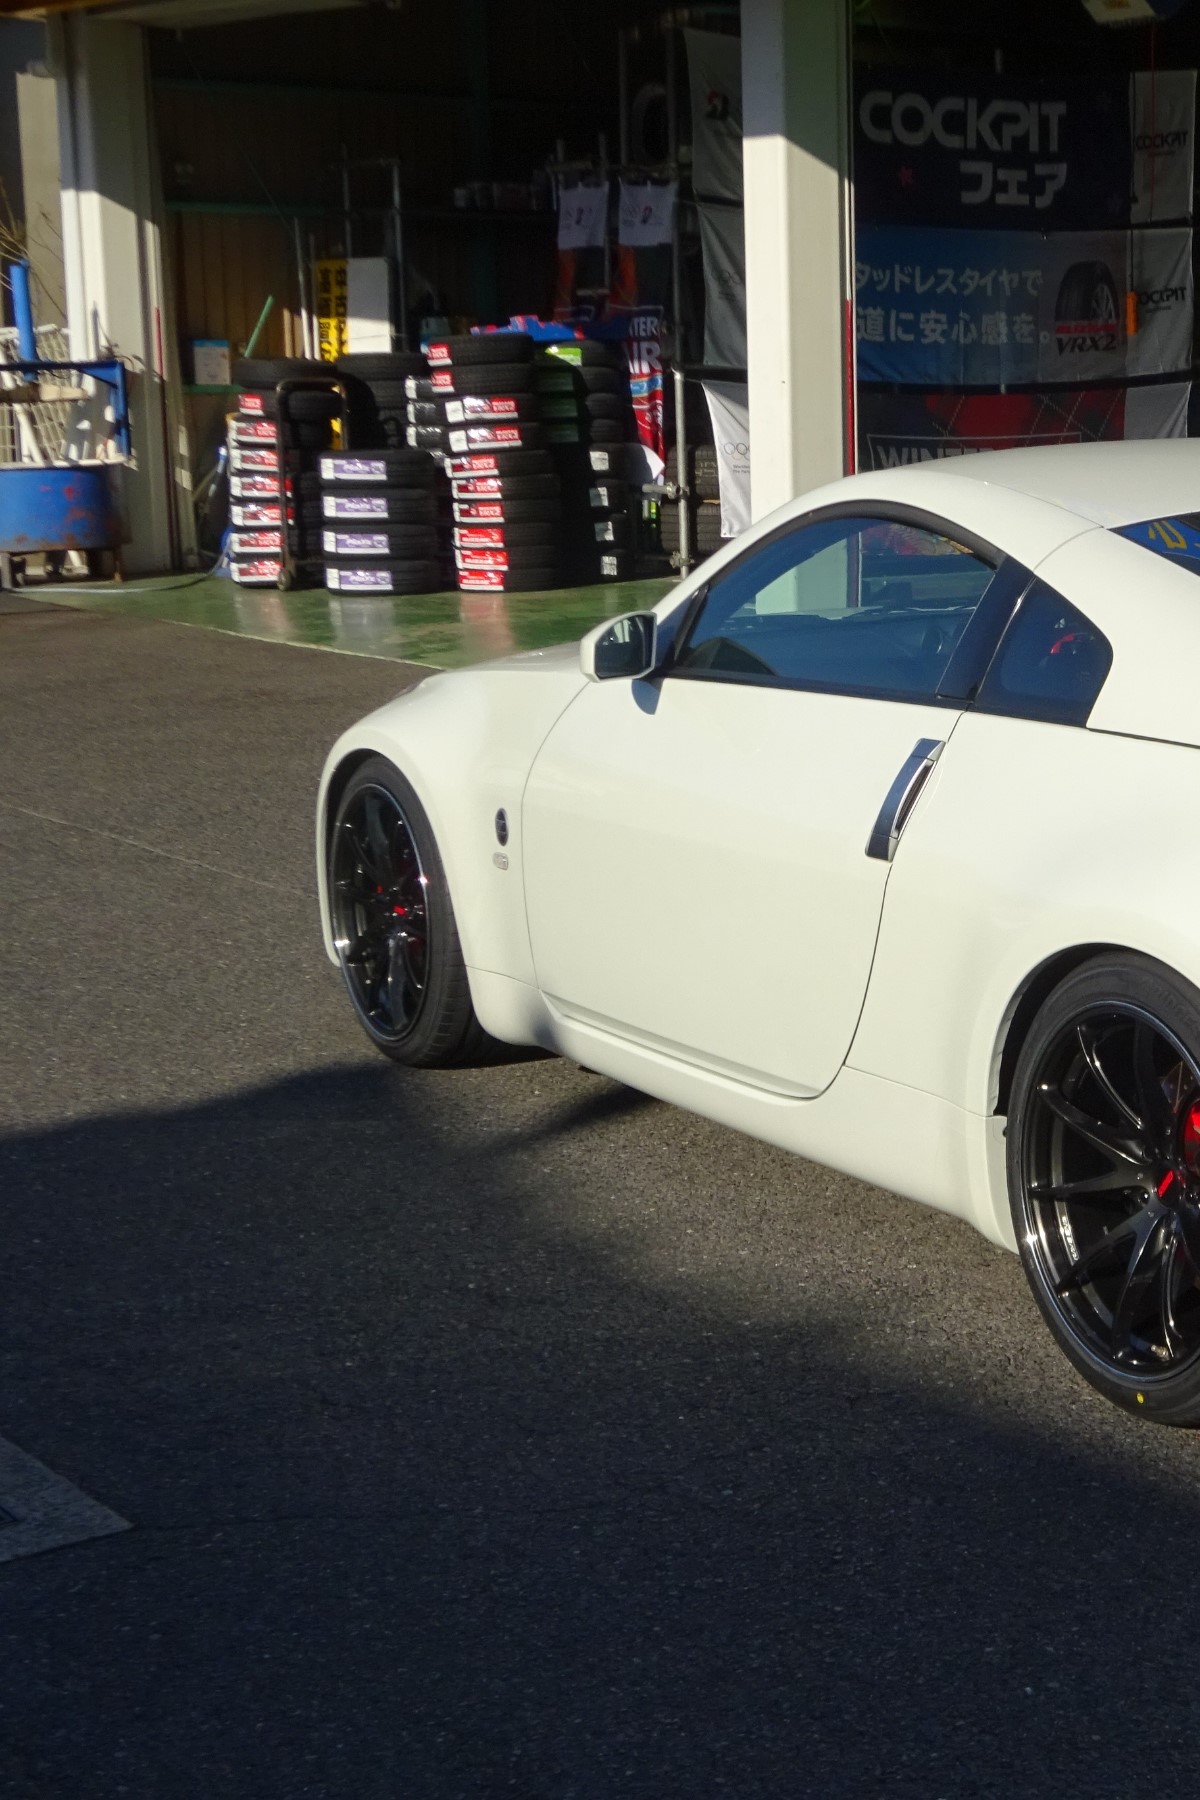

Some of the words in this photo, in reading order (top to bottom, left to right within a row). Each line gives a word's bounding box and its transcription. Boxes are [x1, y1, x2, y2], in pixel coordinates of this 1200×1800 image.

[859, 89, 1068, 153] COCKPIT
[1136, 131, 1188, 150] COCKPIT
[959, 160, 1068, 209] フェア
[1056, 333, 1117, 356] VRX2
